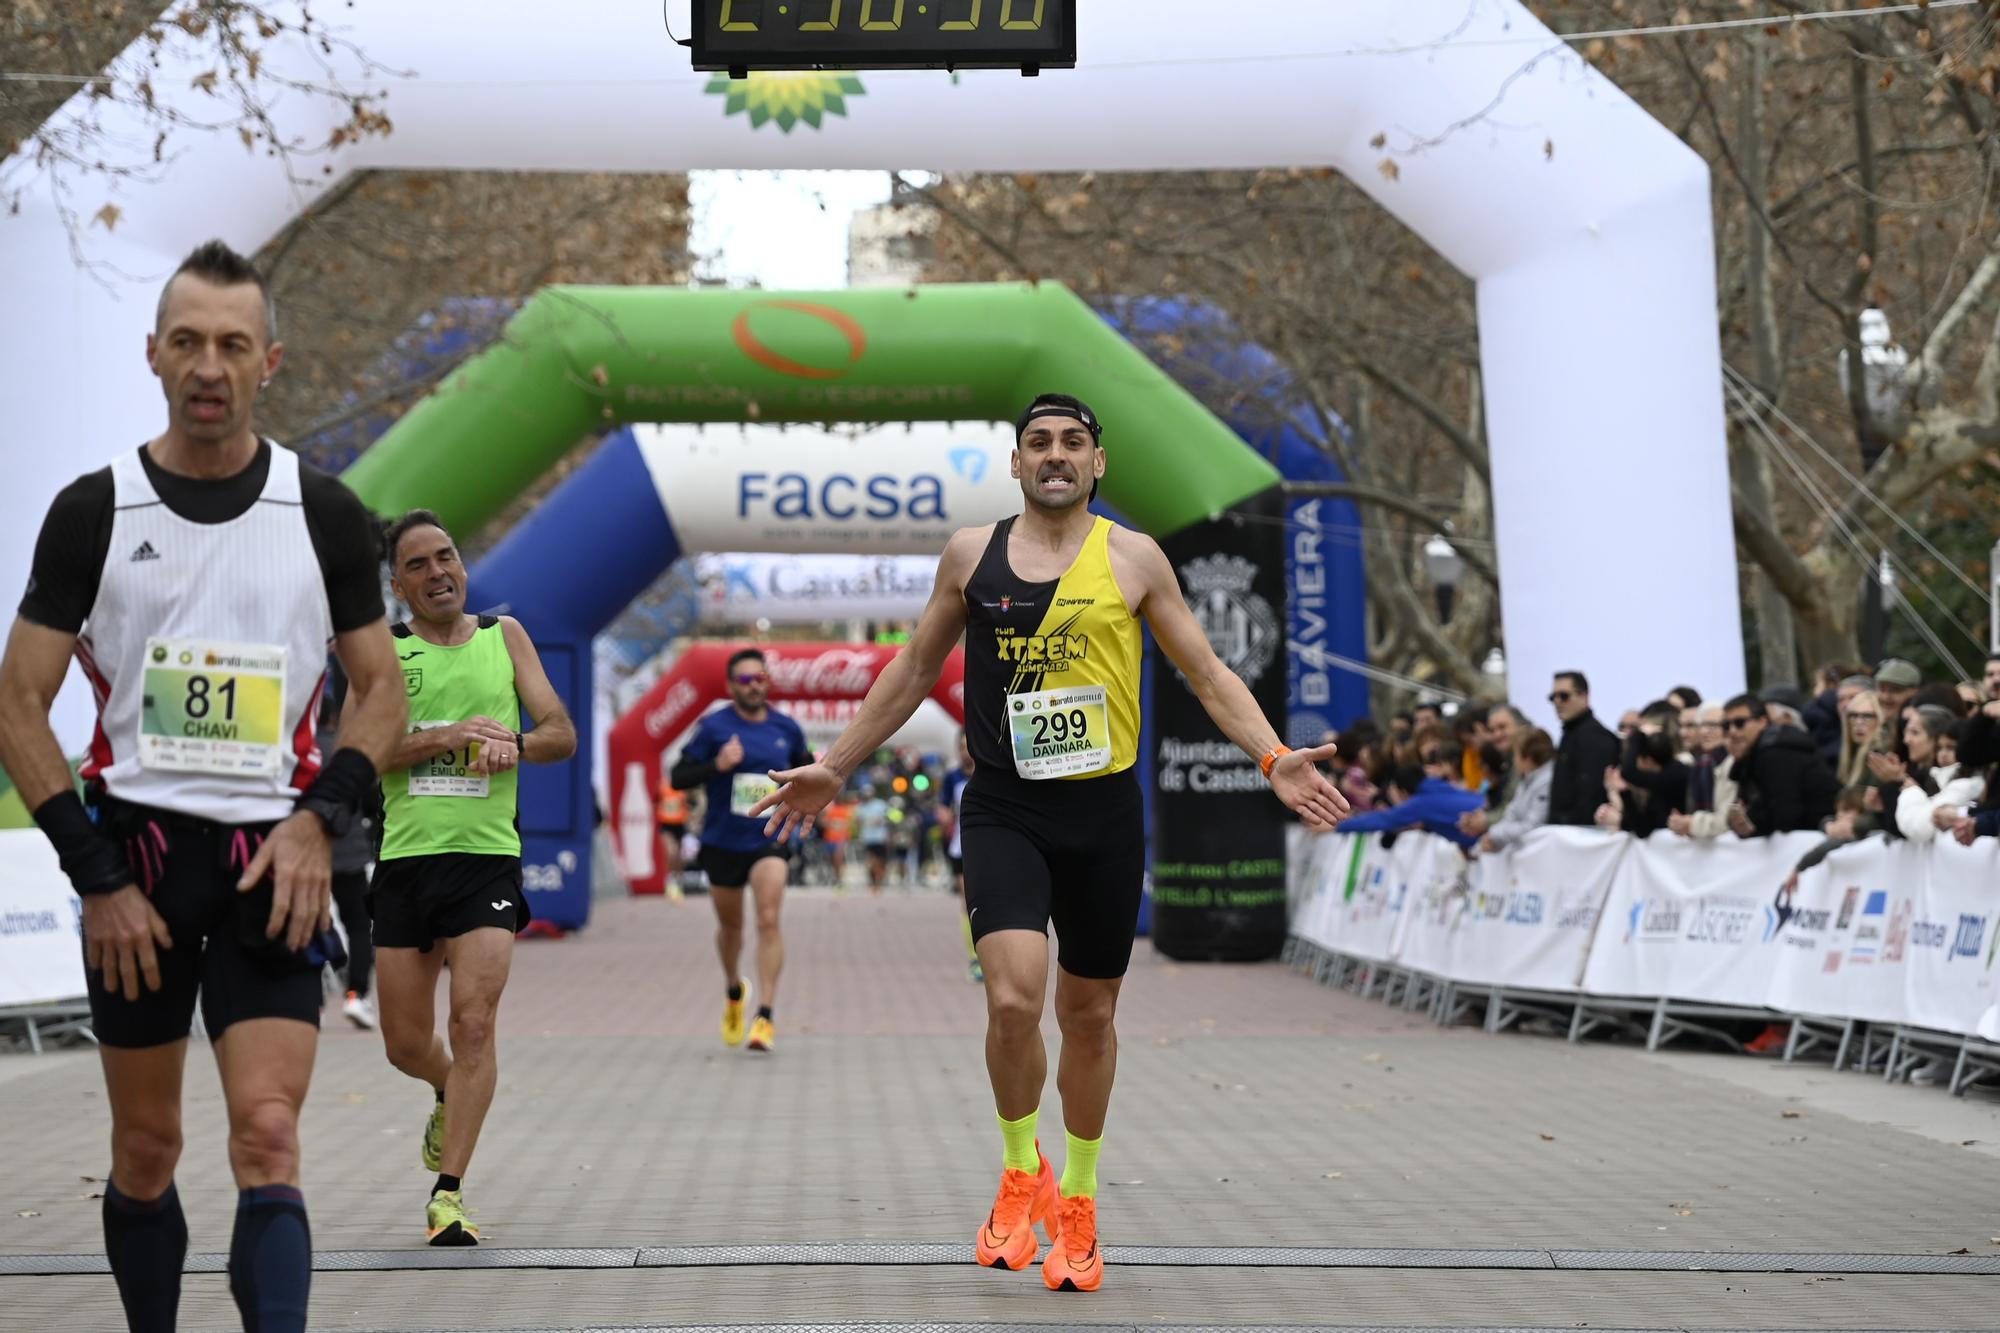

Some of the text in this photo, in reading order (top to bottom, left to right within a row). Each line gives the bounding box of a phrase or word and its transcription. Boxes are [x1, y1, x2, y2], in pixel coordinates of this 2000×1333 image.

[768, 562, 938, 598] CaixaBan
[1293, 499, 1331, 705] BAVIERA
[995, 627, 1015, 635] CLUB
[996, 633, 1088, 661] XTREM
[1016, 661, 1070, 673] ALMENARA
[184, 675, 236, 721] 81
[183, 721, 238, 740] CHAVI
[1031, 709, 1087, 745] 299
[1032, 739, 1093, 758] DAVINARA
[1158, 736, 1248, 766] Ajuntam
[431, 767, 466, 777] EMILIO
[1159, 764, 1186, 792] de
